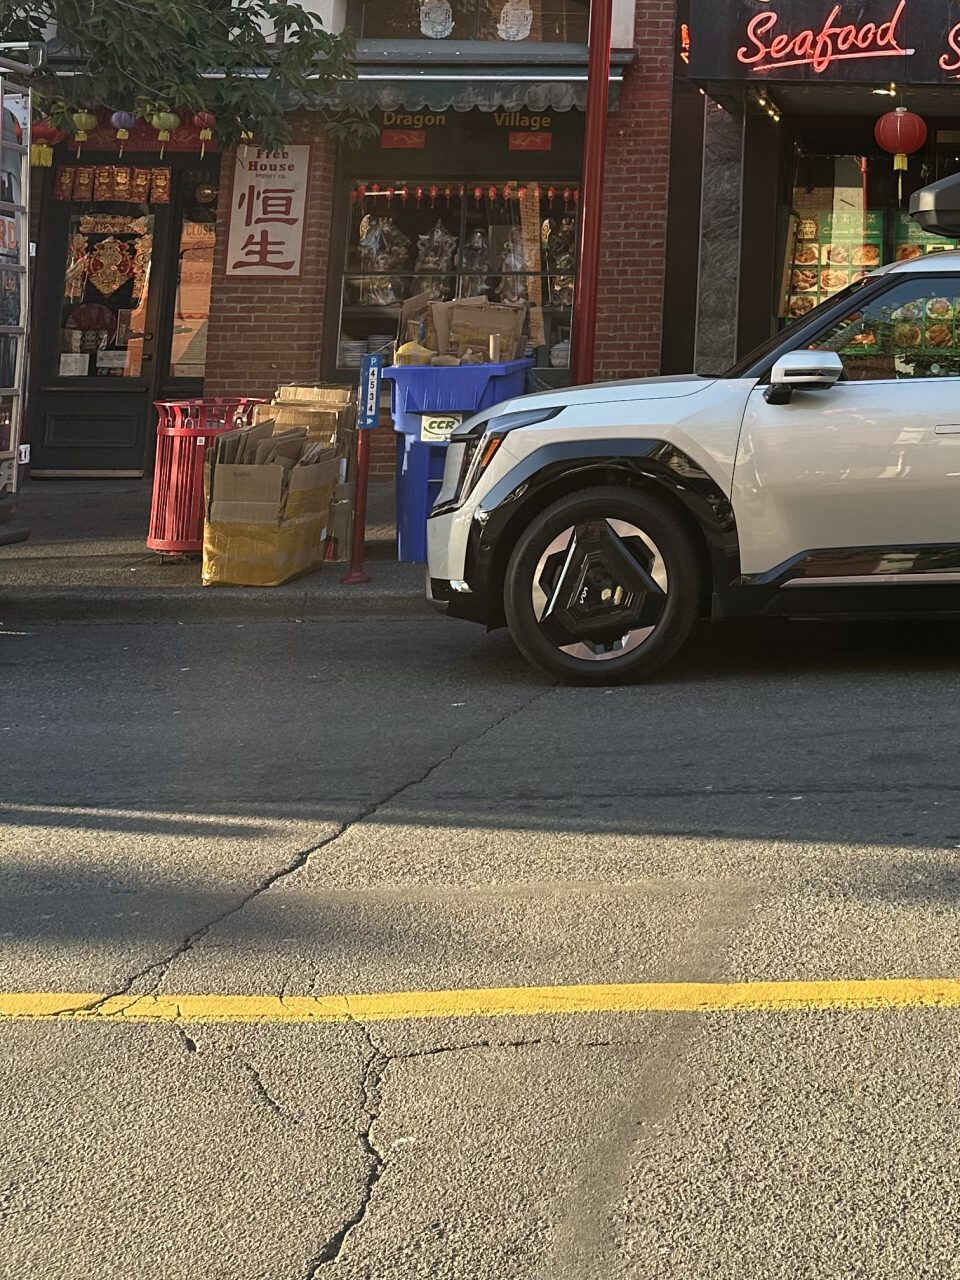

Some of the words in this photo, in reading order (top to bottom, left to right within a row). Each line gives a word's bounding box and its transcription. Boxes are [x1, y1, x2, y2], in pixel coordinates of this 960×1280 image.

[737, 0, 906, 73] Seafood
[383, 111, 448, 129] Dragon
[494, 112, 552, 130] Village
[248, 160, 296, 172] House
[232, 184, 298, 270] 恒生
[367, 368, 377, 413] 4534
[428, 420, 456, 430] CCR
